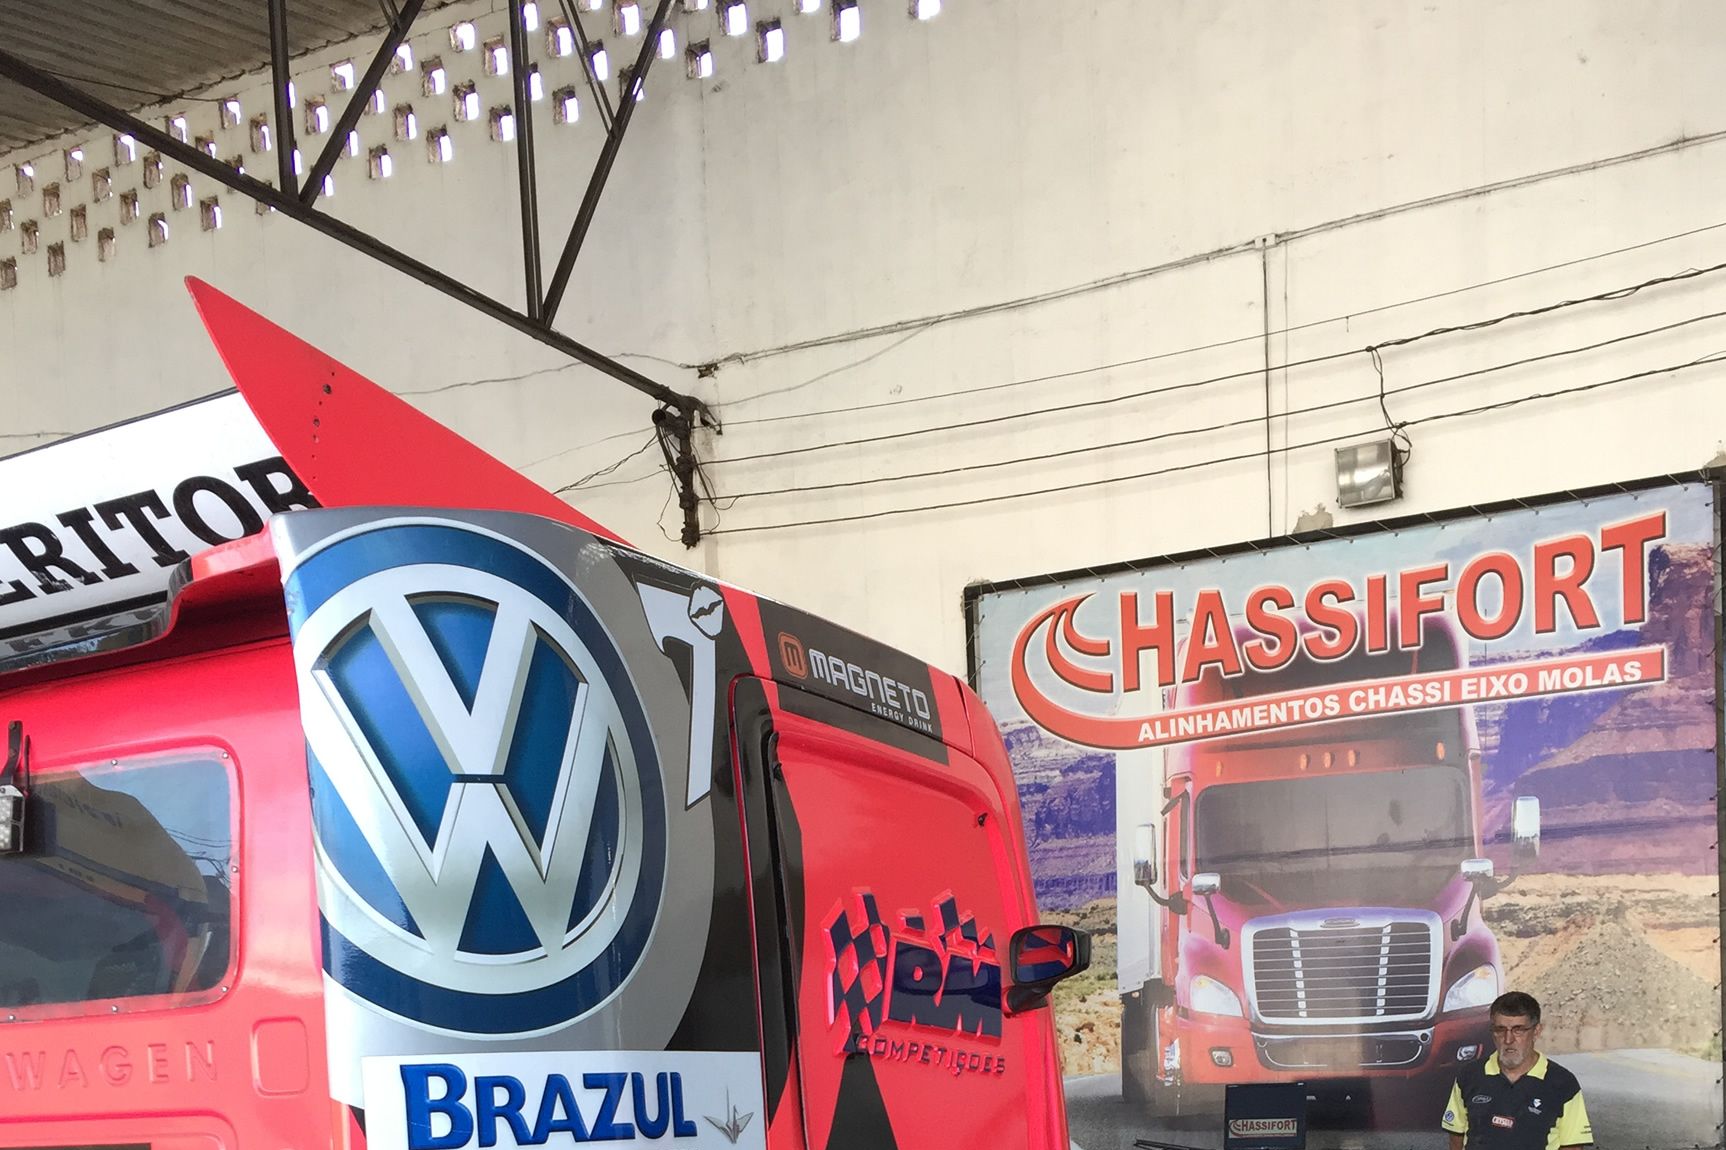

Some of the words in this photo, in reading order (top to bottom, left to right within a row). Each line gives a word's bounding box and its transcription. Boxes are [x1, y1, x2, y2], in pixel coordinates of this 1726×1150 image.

[0, 456, 324, 605] RITOR
[808, 648, 931, 721] MAGNETO
[871, 702, 904, 723] ENERGY
[908, 715, 933, 734] DRINK
[1138, 690, 1340, 742] ALINHAMENTOS
[1348, 680, 1450, 711] CHASSI
[1461, 672, 1528, 700] EIXO
[1538, 660, 1642, 691] MOLAS
